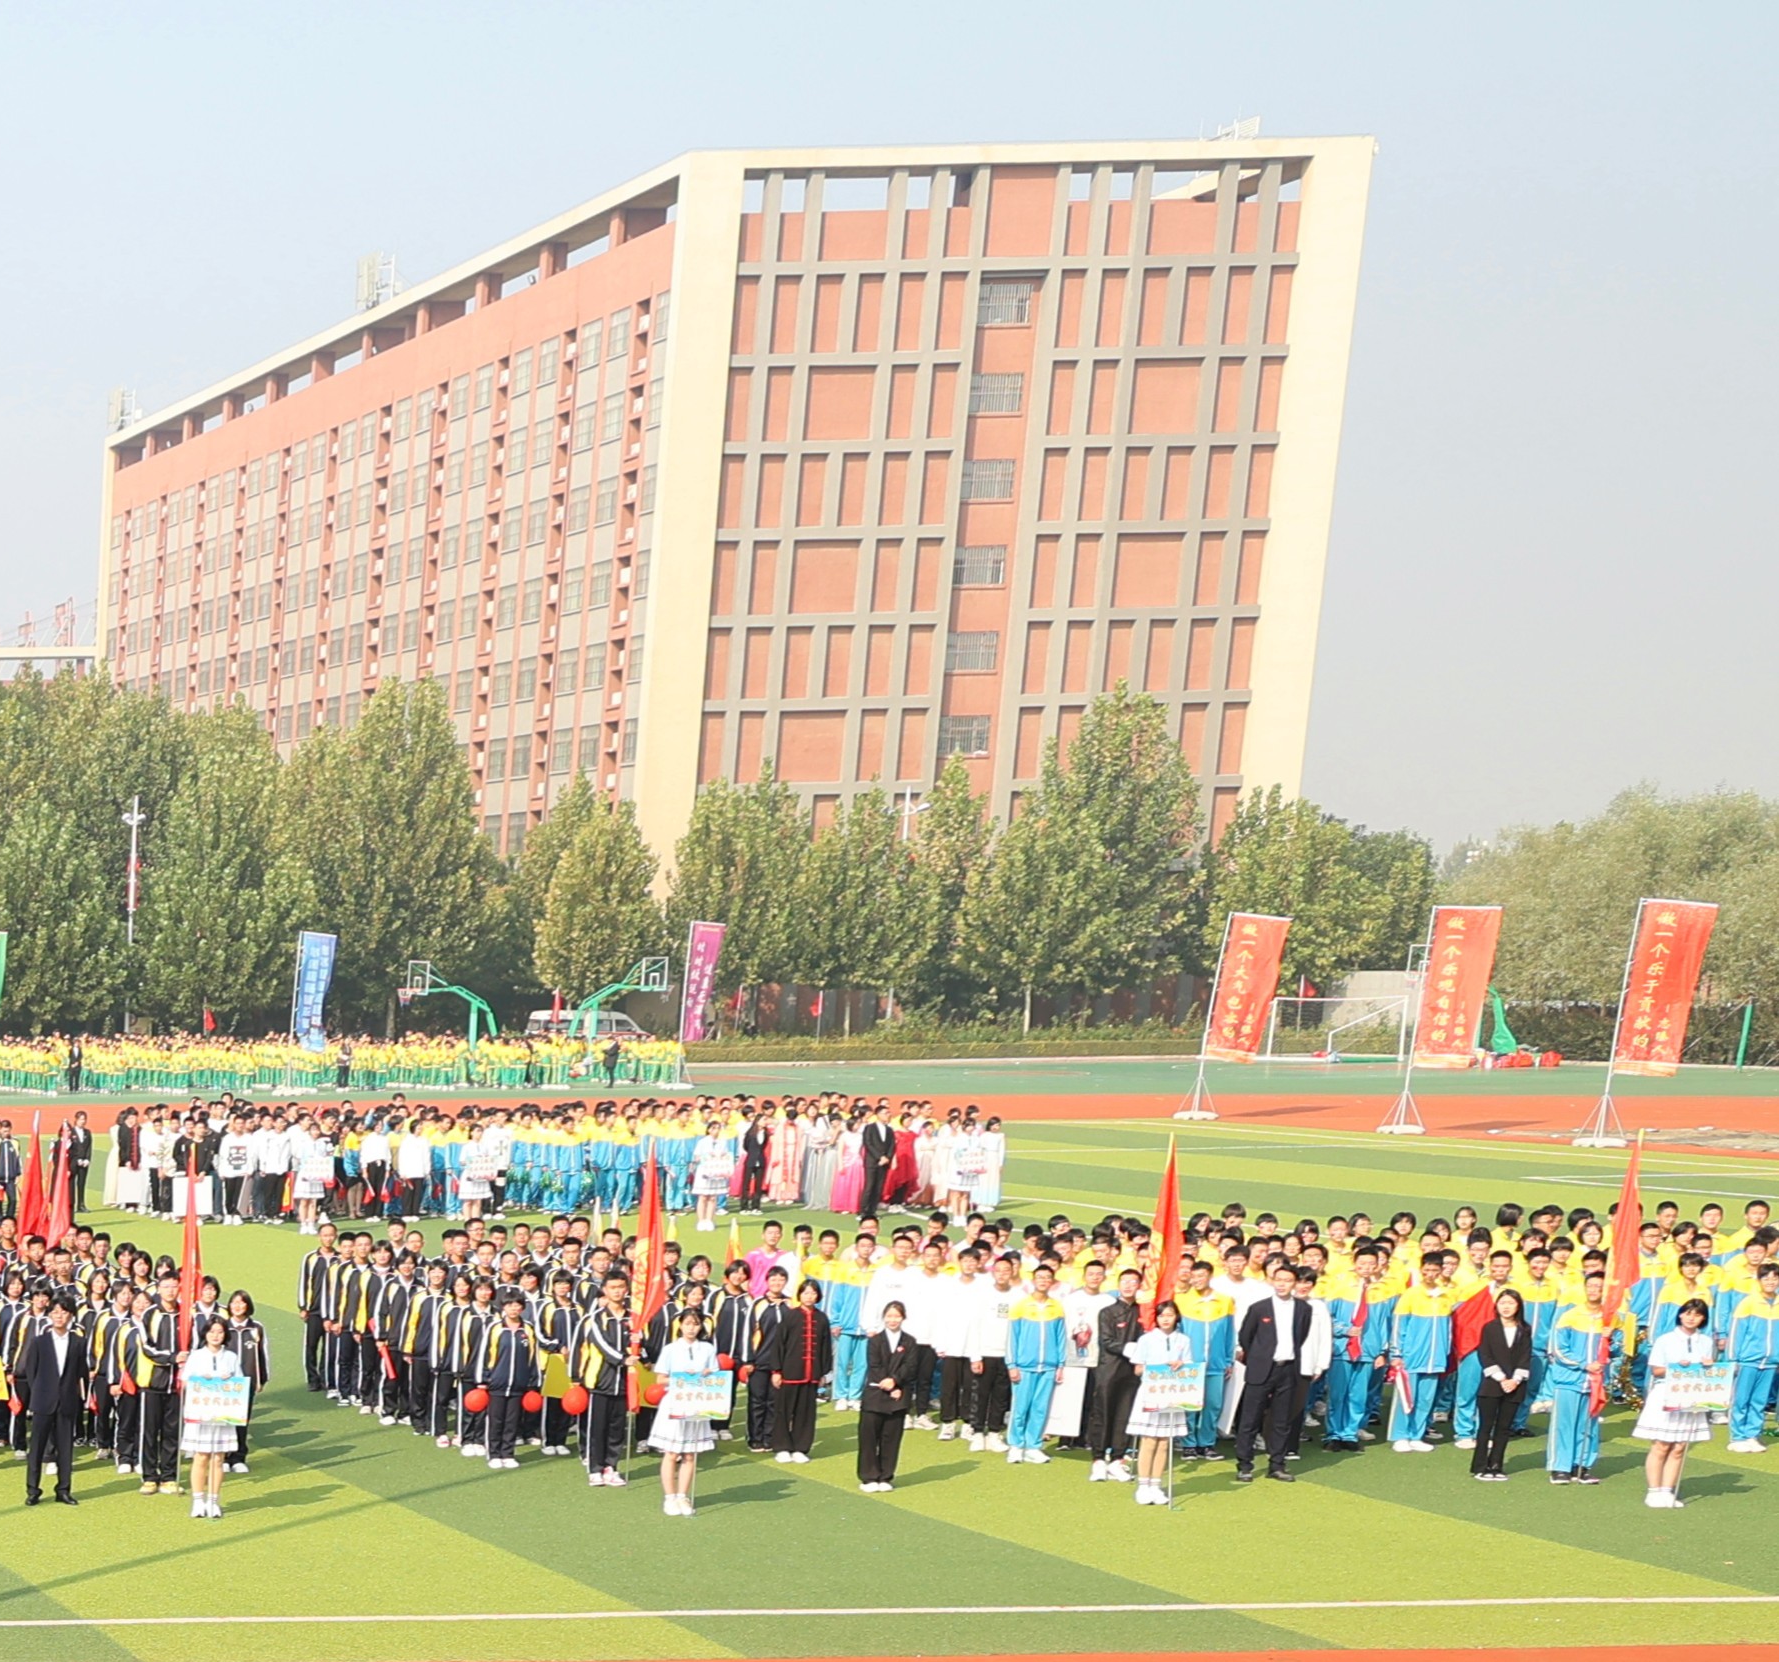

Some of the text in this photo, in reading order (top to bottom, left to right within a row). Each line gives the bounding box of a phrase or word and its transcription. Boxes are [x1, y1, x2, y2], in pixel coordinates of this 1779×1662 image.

[1430, 916, 1467, 1042] 做一个乐观自信的
[1632, 911, 1678, 1048] 做一个乐于贡献的
